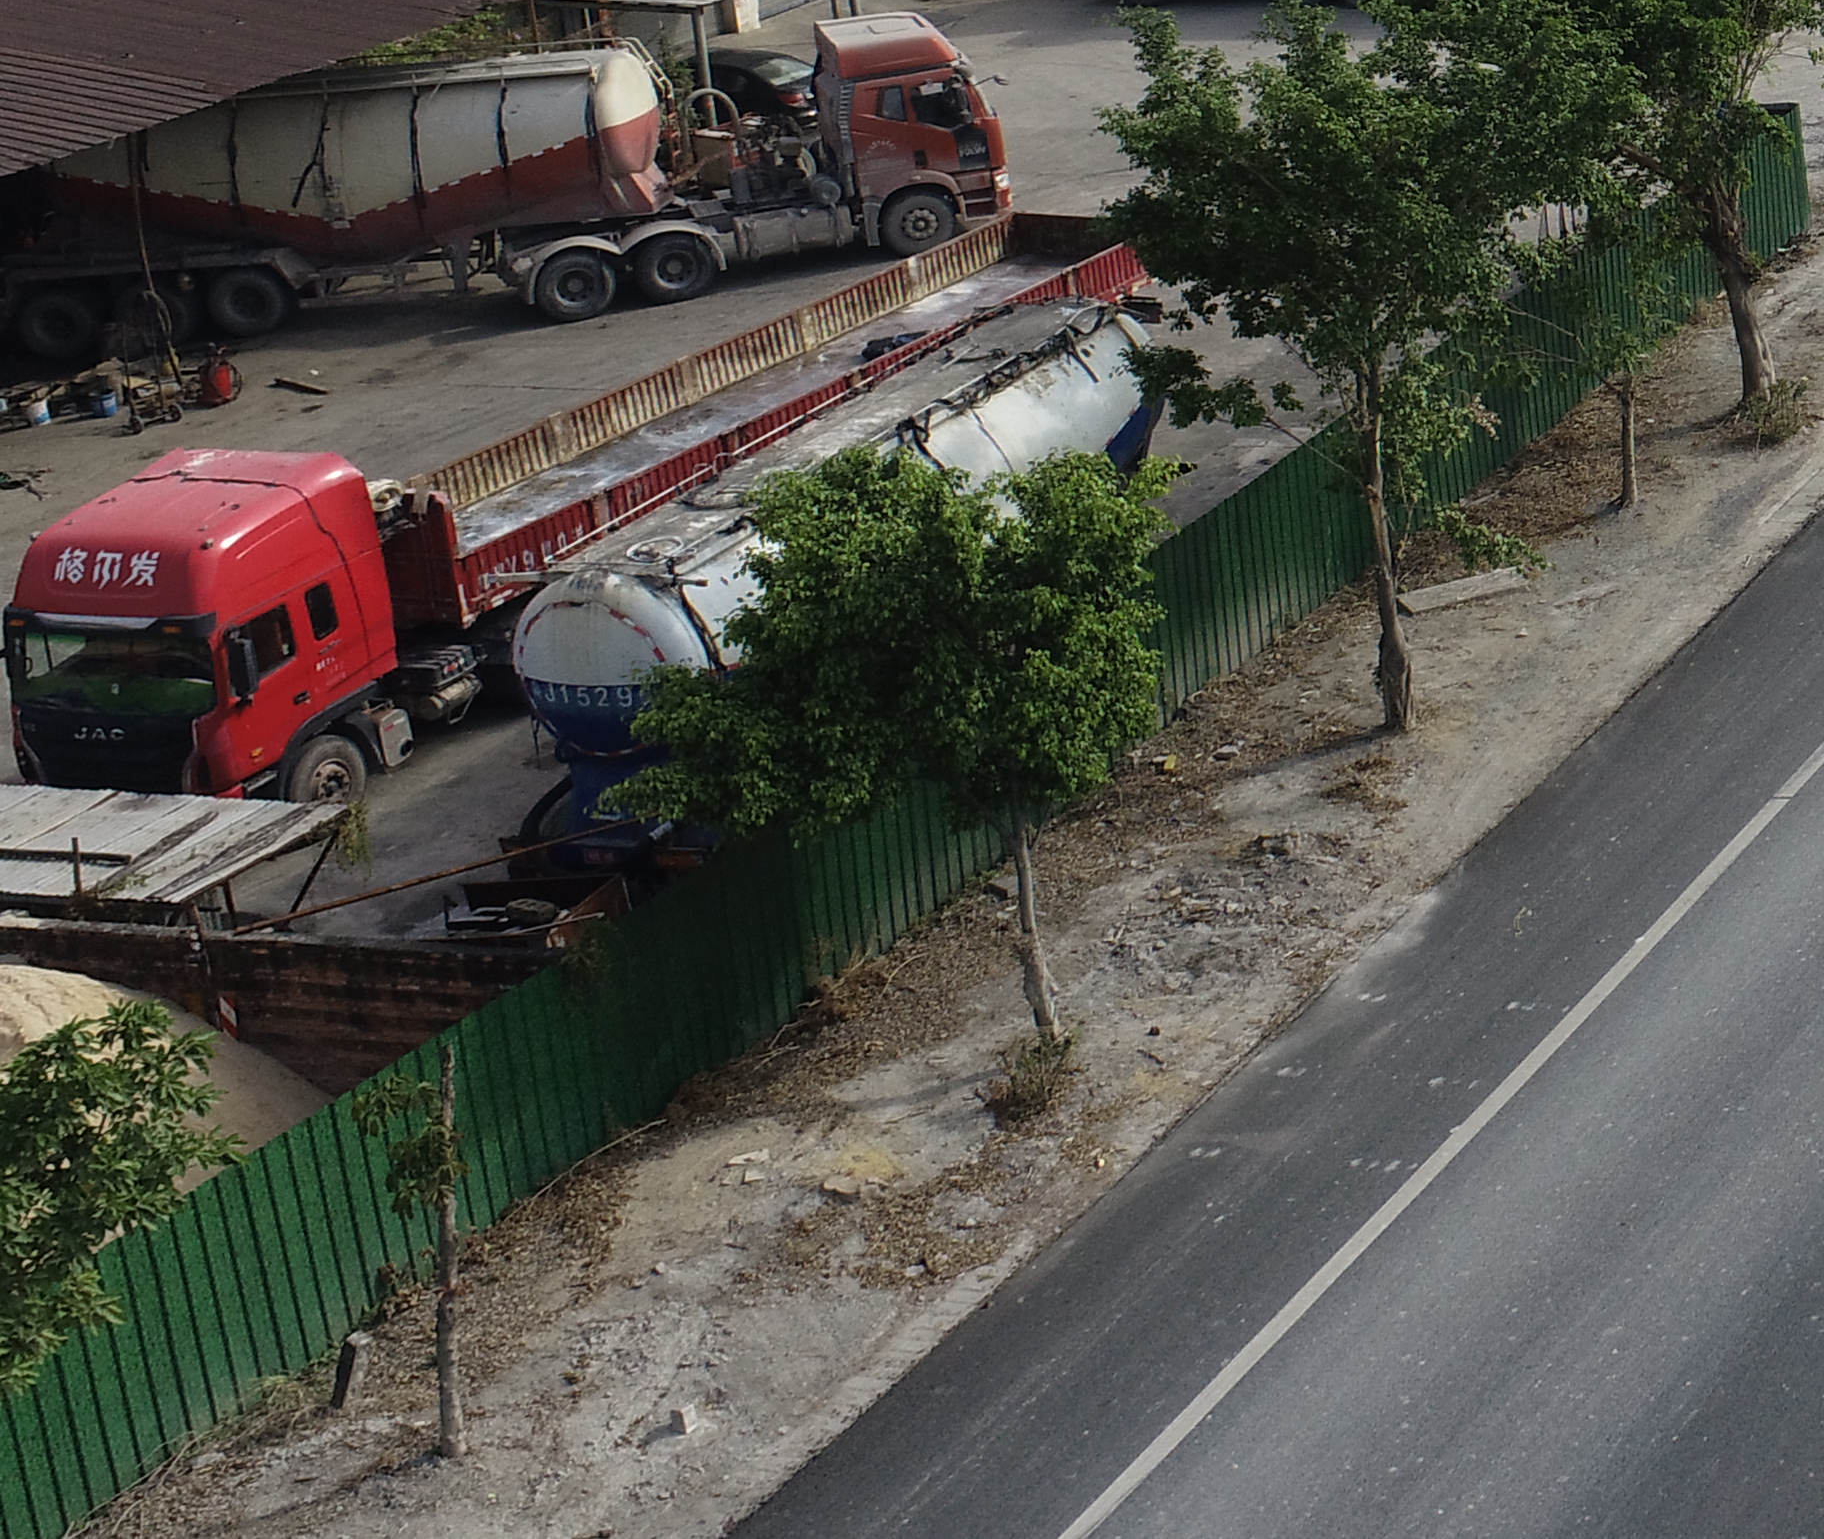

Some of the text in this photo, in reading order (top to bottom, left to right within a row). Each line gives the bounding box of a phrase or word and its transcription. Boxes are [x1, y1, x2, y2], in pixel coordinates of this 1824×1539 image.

[53, 546, 160, 590] 格尔发
[73, 725, 126, 741] JAC
